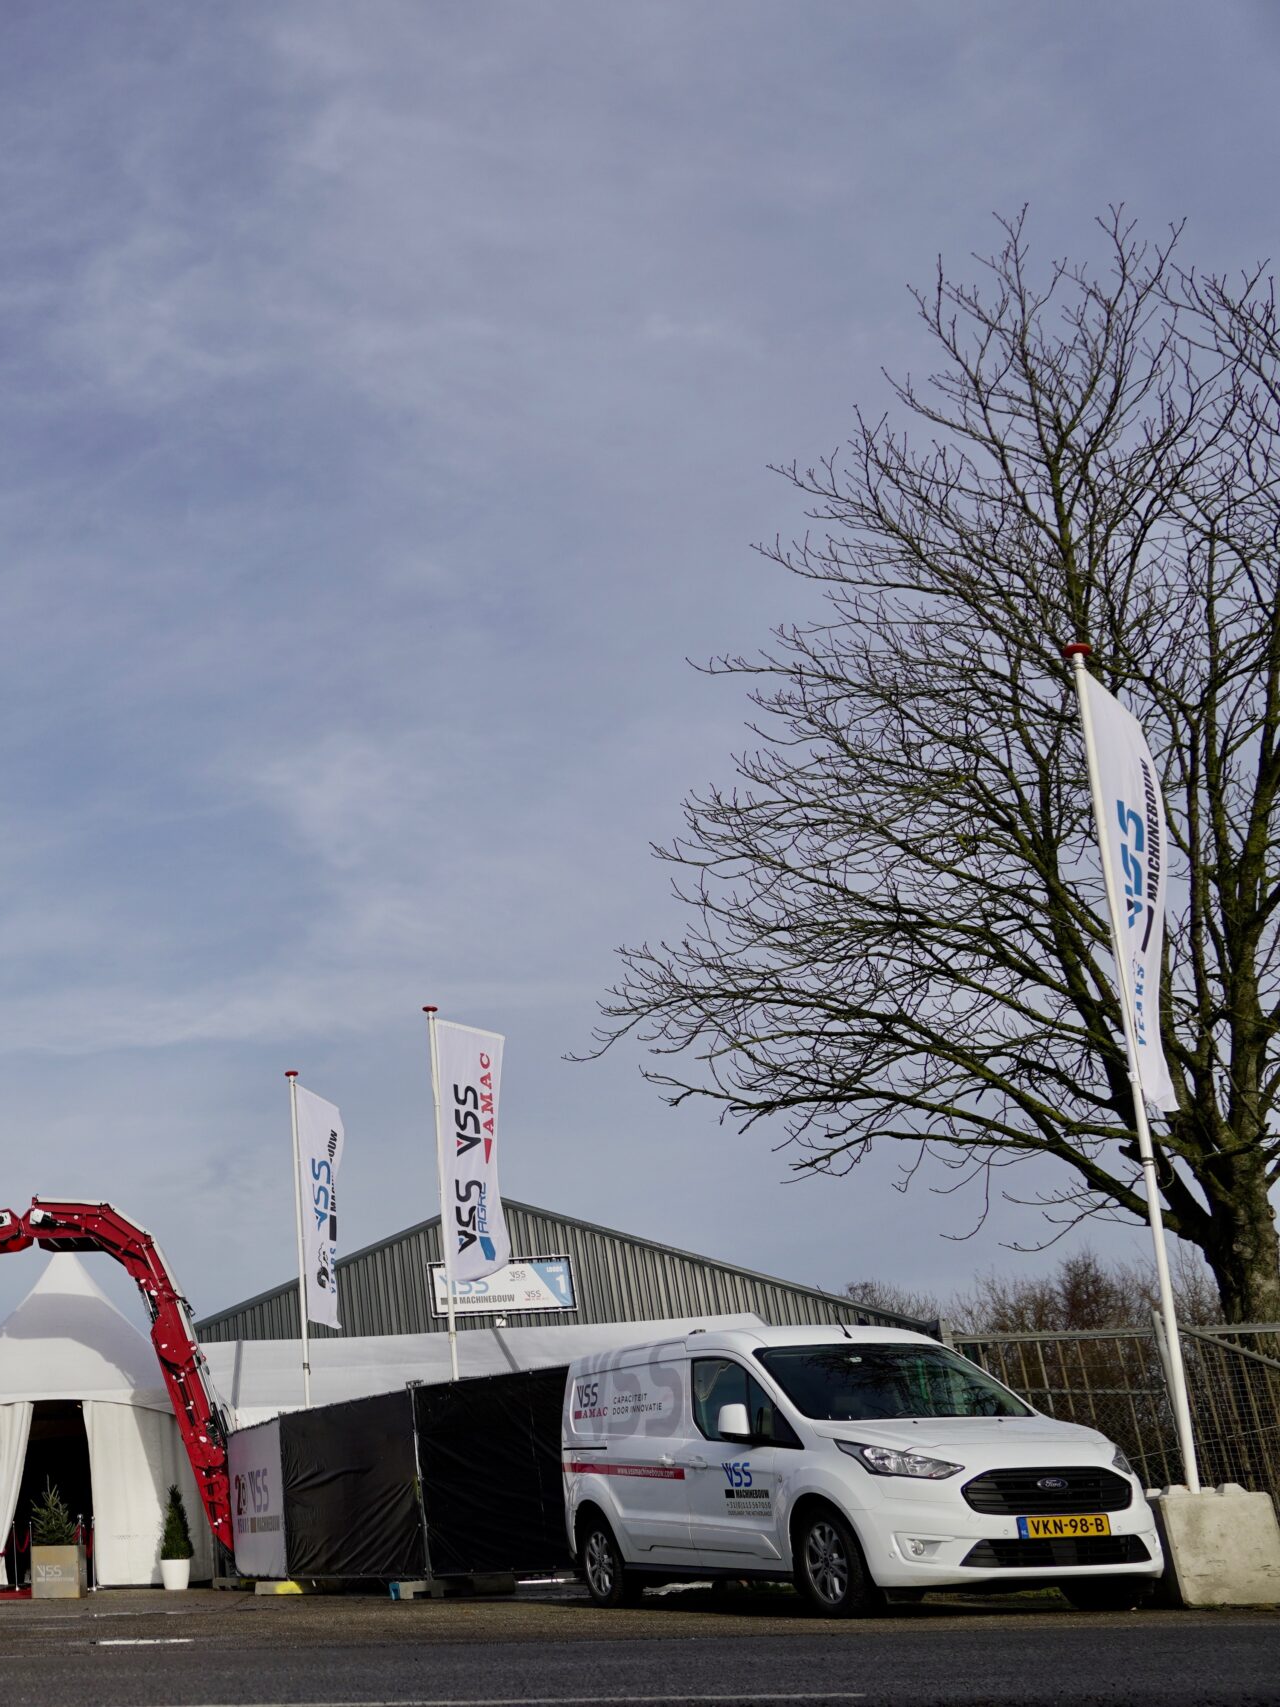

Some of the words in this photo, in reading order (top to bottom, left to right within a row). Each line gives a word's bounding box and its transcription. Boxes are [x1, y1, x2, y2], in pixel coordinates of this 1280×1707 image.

[1140, 757, 1160, 904] MACHINEBOUW
[1117, 799, 1144, 929] VSS
[479, 1052, 494, 1135] AMAC
[453, 1084, 482, 1157] VSS
[311, 1158, 331, 1232] VSS
[455, 1179, 483, 1255] VSS
[509, 1270, 526, 1279] VSS
[556, 1274, 567, 1294] 1
[459, 1294, 515, 1304] MACHINEBOUW
[577, 1383, 599, 1408] VSS
[613, 1393, 648, 1404] CAPACITEIT
[582, 1406, 608, 1419] AMAC
[612, 1406, 629, 1415] DOOR
[630, 1402, 662, 1414] INNOVATIE
[721, 1462, 752, 1487] VSS
[1045, 1480, 1062, 1488] Ford
[248, 1468, 269, 1513] VSS
[735, 1489, 769, 1498] MACHINEBOUW
[1031, 1518, 1105, 1535] VKN-98-B
[37, 1565, 62, 1577] VSS
